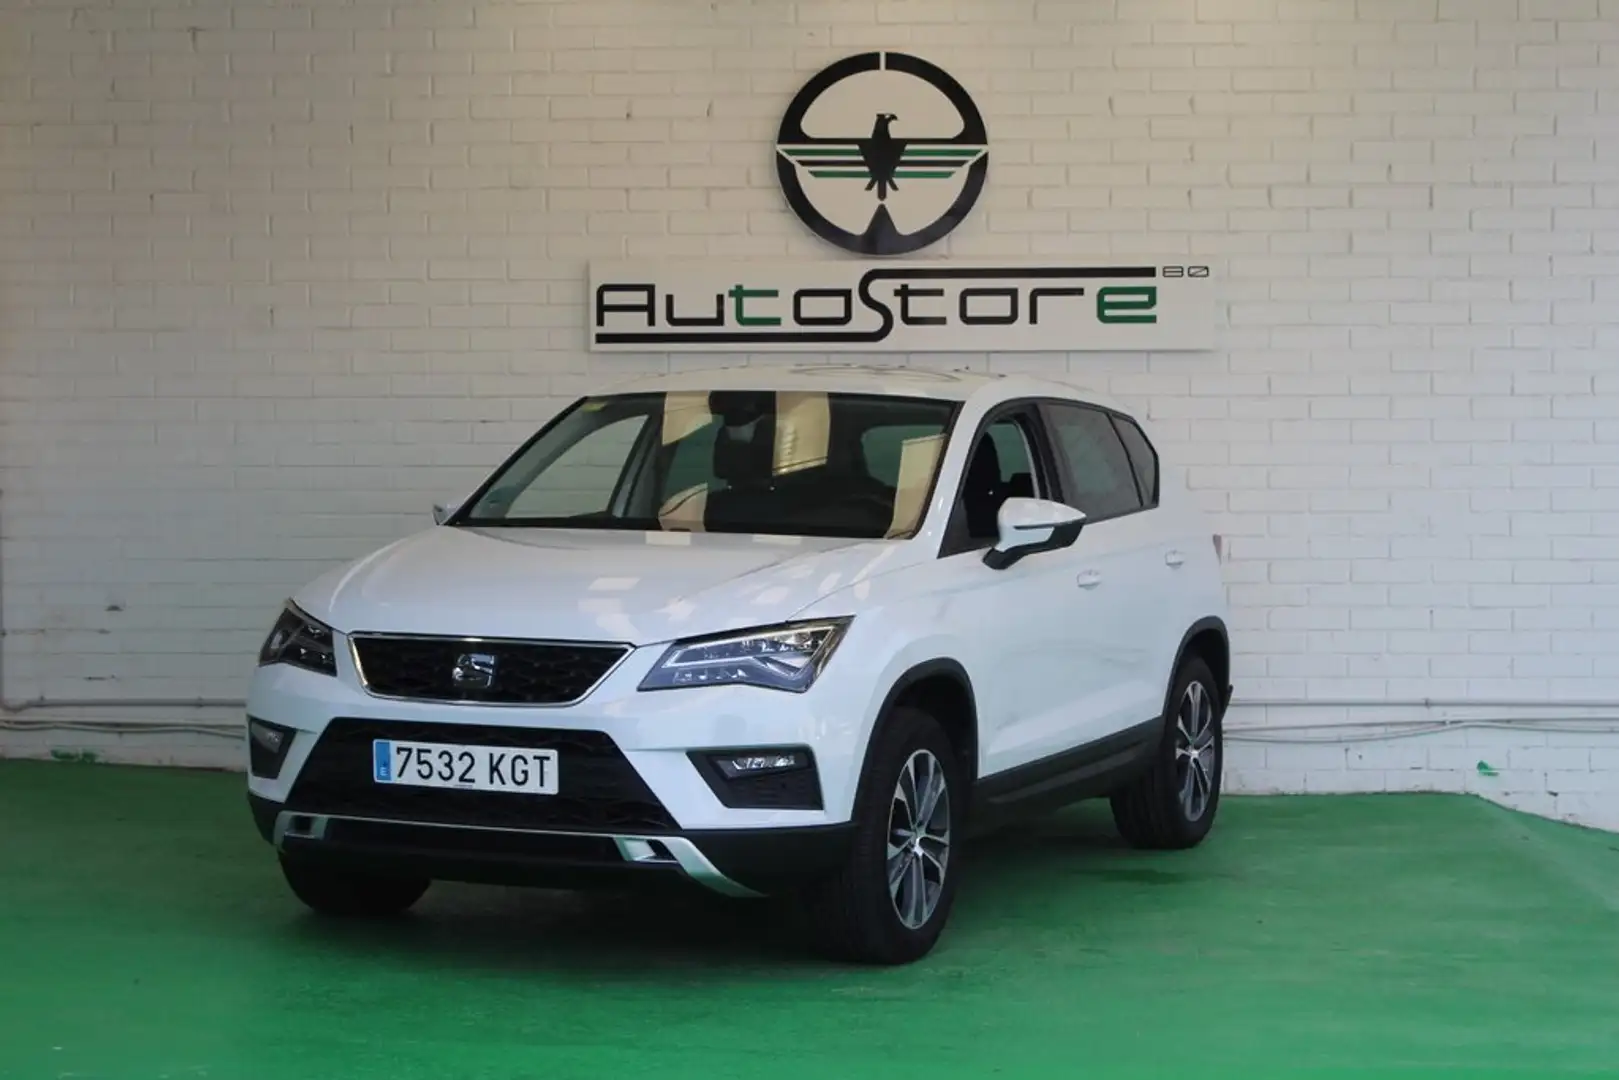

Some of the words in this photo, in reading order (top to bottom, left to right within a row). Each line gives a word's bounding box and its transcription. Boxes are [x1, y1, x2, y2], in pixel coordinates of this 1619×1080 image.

[595, 266, 1157, 343] AutoStore
[396, 746, 476, 784] 7532
[489, 752, 551, 787] KGT
